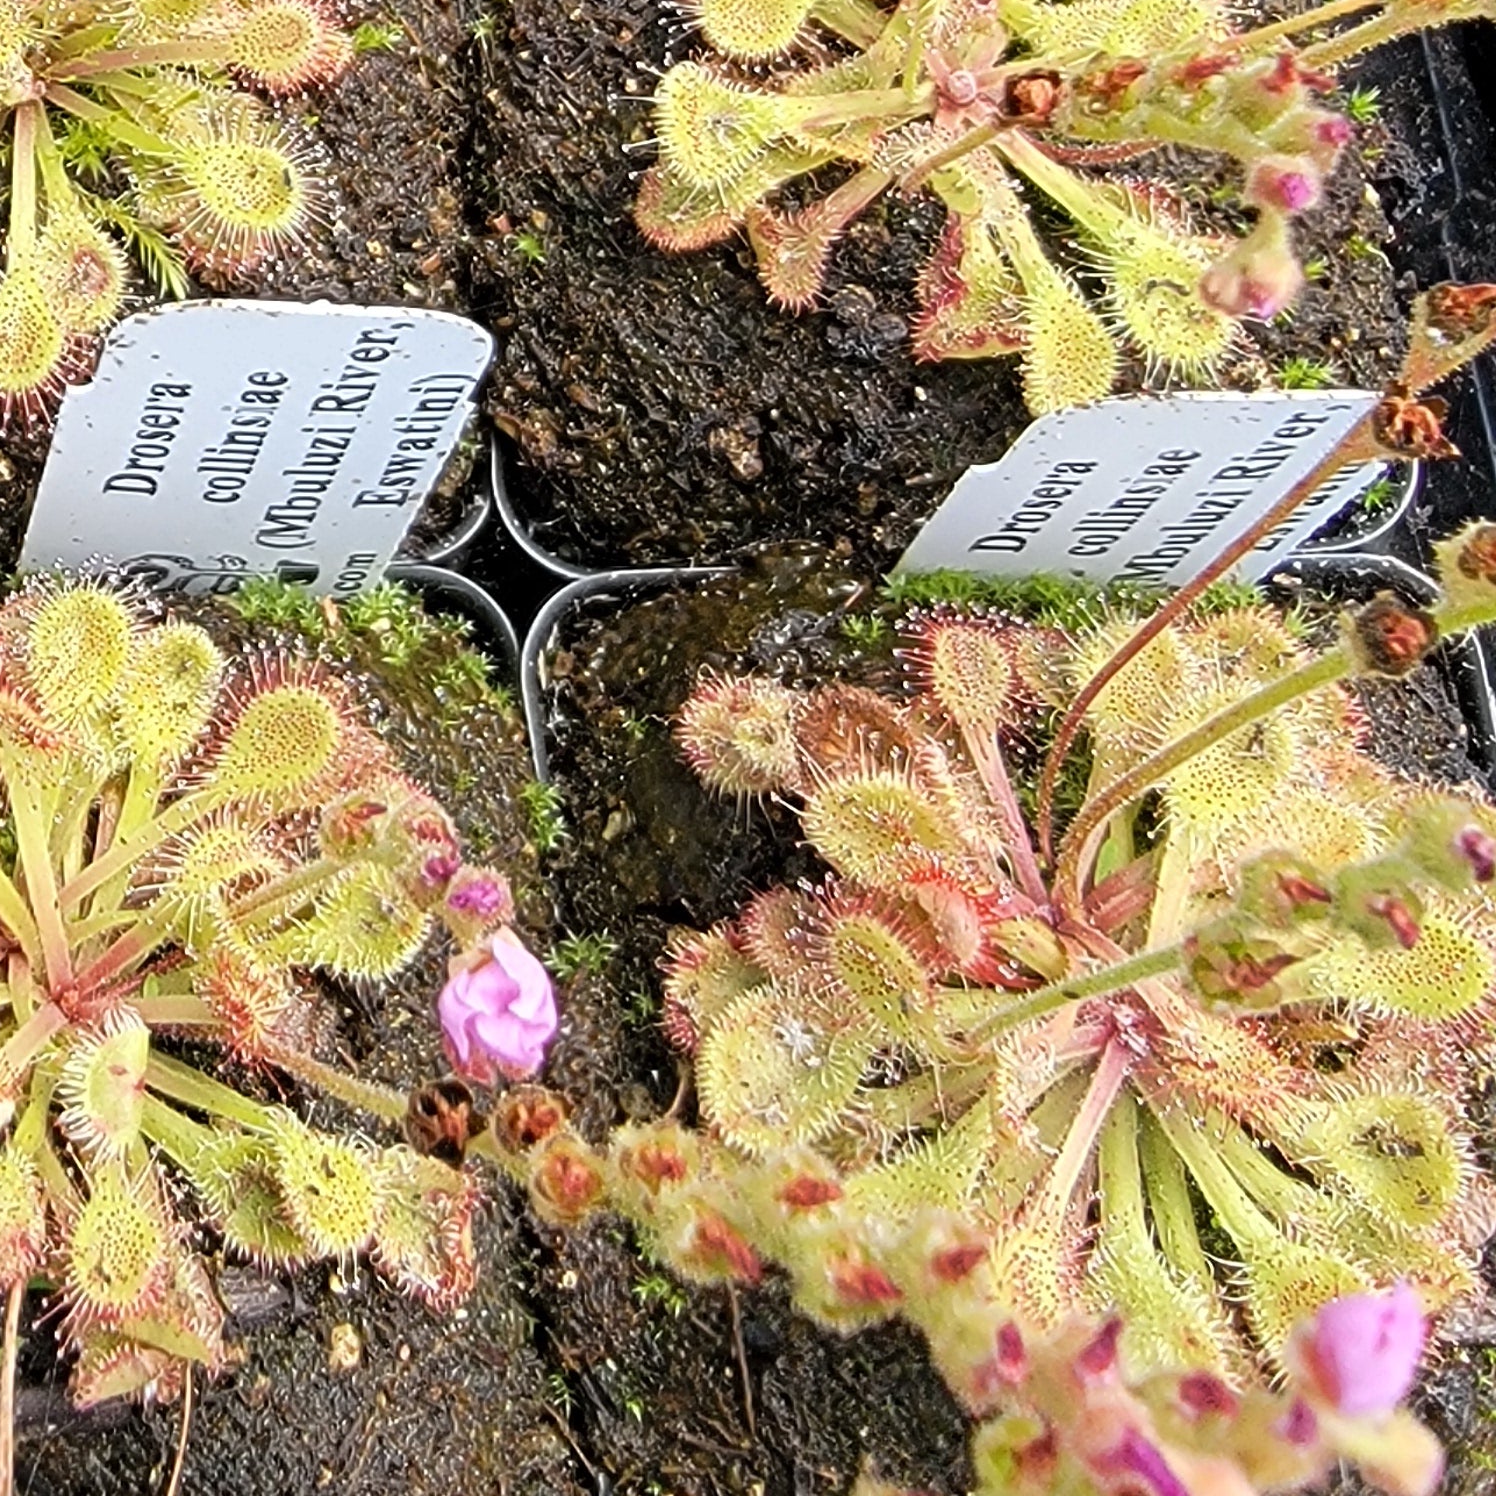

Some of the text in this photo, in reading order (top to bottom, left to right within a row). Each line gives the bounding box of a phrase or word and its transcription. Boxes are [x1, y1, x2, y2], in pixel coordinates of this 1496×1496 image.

[103, 381, 193, 496] Drosera
[255, 322, 415, 549] (Mbuluzi River,
[352, 374, 475, 507] Eswatini)
[1107, 490, 1253, 584] Mbuluzi
[1208, 404, 1352, 483] River,
[968, 459, 1099, 554] Drosera
